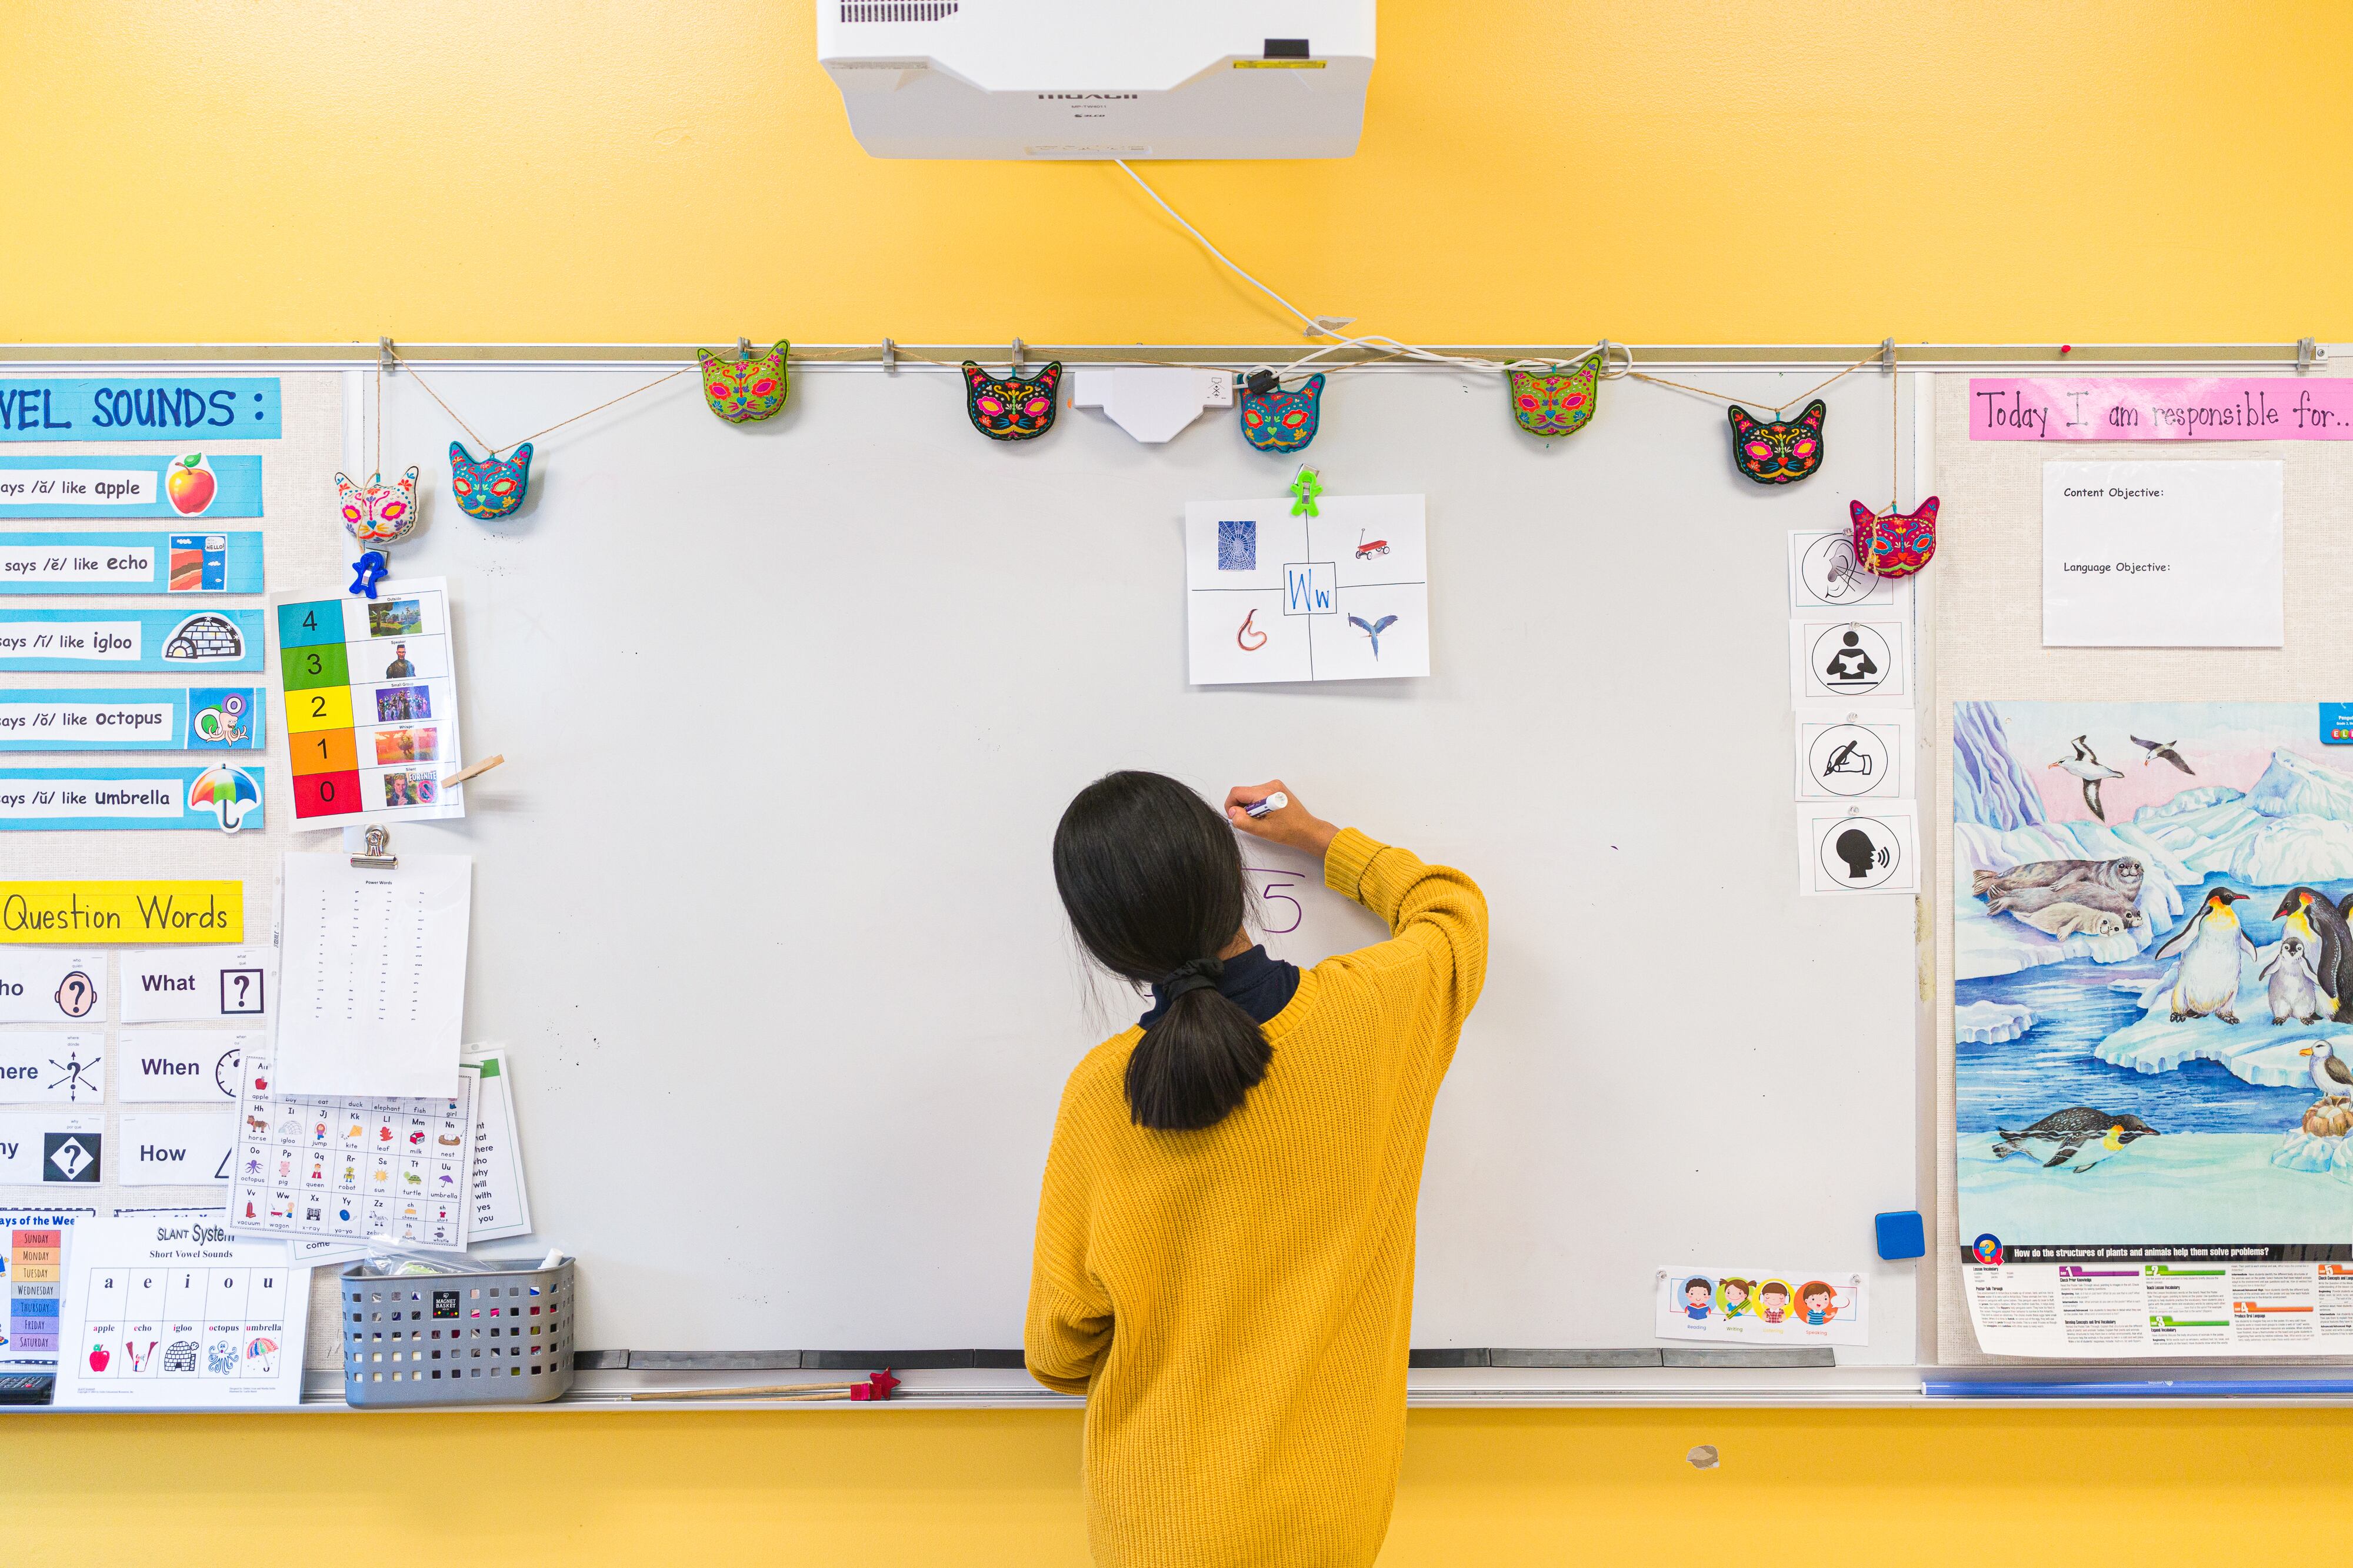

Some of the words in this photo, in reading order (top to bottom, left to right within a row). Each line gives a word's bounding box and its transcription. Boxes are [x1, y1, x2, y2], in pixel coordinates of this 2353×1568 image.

[1977, 391, 2048, 438] Today
[2066, 391, 2088, 427] I
[2109, 406, 2138, 427] am
[2153, 391, 2279, 436] responsible
[63, 481, 86, 493] like
[95, 480, 139, 499] apple
[2064, 488, 2104, 496] Content
[2109, 488, 2163, 499] Objective:
[5, 562, 36, 575] says
[75, 558, 98, 570] like
[107, 555, 147, 569] echo
[2064, 562, 2111, 573] Language
[2117, 562, 2169, 574] Objective:
[303, 610, 317, 630] 4
[61, 635, 84, 648] like
[94, 632, 131, 653] igloo
[307, 654, 322, 675] 3
[312, 696, 326, 717] 2
[0, 718, 25, 730] ays
[64, 713, 87, 725] like
[96, 712, 162, 729] octopus
[318, 739, 327, 759] 1
[409, 772, 436, 783] FORTNITE
[320, 781, 335, 802] 0
[0, 795, 25, 808] ays
[63, 792, 86, 804] like
[95, 790, 169, 805] umbrella
[4, 893, 120, 930] Question
[136, 894, 226, 929] Words
[1261, 884, 1301, 933] 5
[142, 975, 195, 991] What
[142, 1059, 199, 1075] When
[141, 1145, 186, 1161] How
[315, 1153, 324, 1161] Qq
[20, 1216, 31, 1225] of
[33, 1216, 49, 1225] the
[52, 1216, 78, 1225] Wee
[479, 1216, 493, 1224] you
[25, 1233, 48, 1243] SUNDAY
[158, 1227, 189, 1241] SLANT
[24, 1251, 48, 1260] MONDAY
[2032, 1249, 2041, 1257] do
[2106, 1248, 2128, 1257] plants
[2145, 1247, 2171, 1256] animals
[2174, 1248, 2188, 1257] help
[2210, 1247, 2229, 1255] solve
[2231, 1247, 2269, 1256] problems?
[24, 1268, 47, 1277] TUESDAY
[2325, 1265, 2334, 1275] 5
[105, 1279, 113, 1288] a
[144, 1279, 152, 1288] e
[185, 1274, 189, 1287] i
[224, 1278, 233, 1288] o
[264, 1278, 272, 1287] u
[18, 1286, 53, 1295] WEDNESDAY
[21, 1303, 49, 1314] THURSDAY
[25, 1320, 44, 1329] FRIDAY
[94, 1325, 114, 1333] apple
[174, 1325, 192, 1333] igloo
[21, 1337, 48, 1347] SATURDAY
